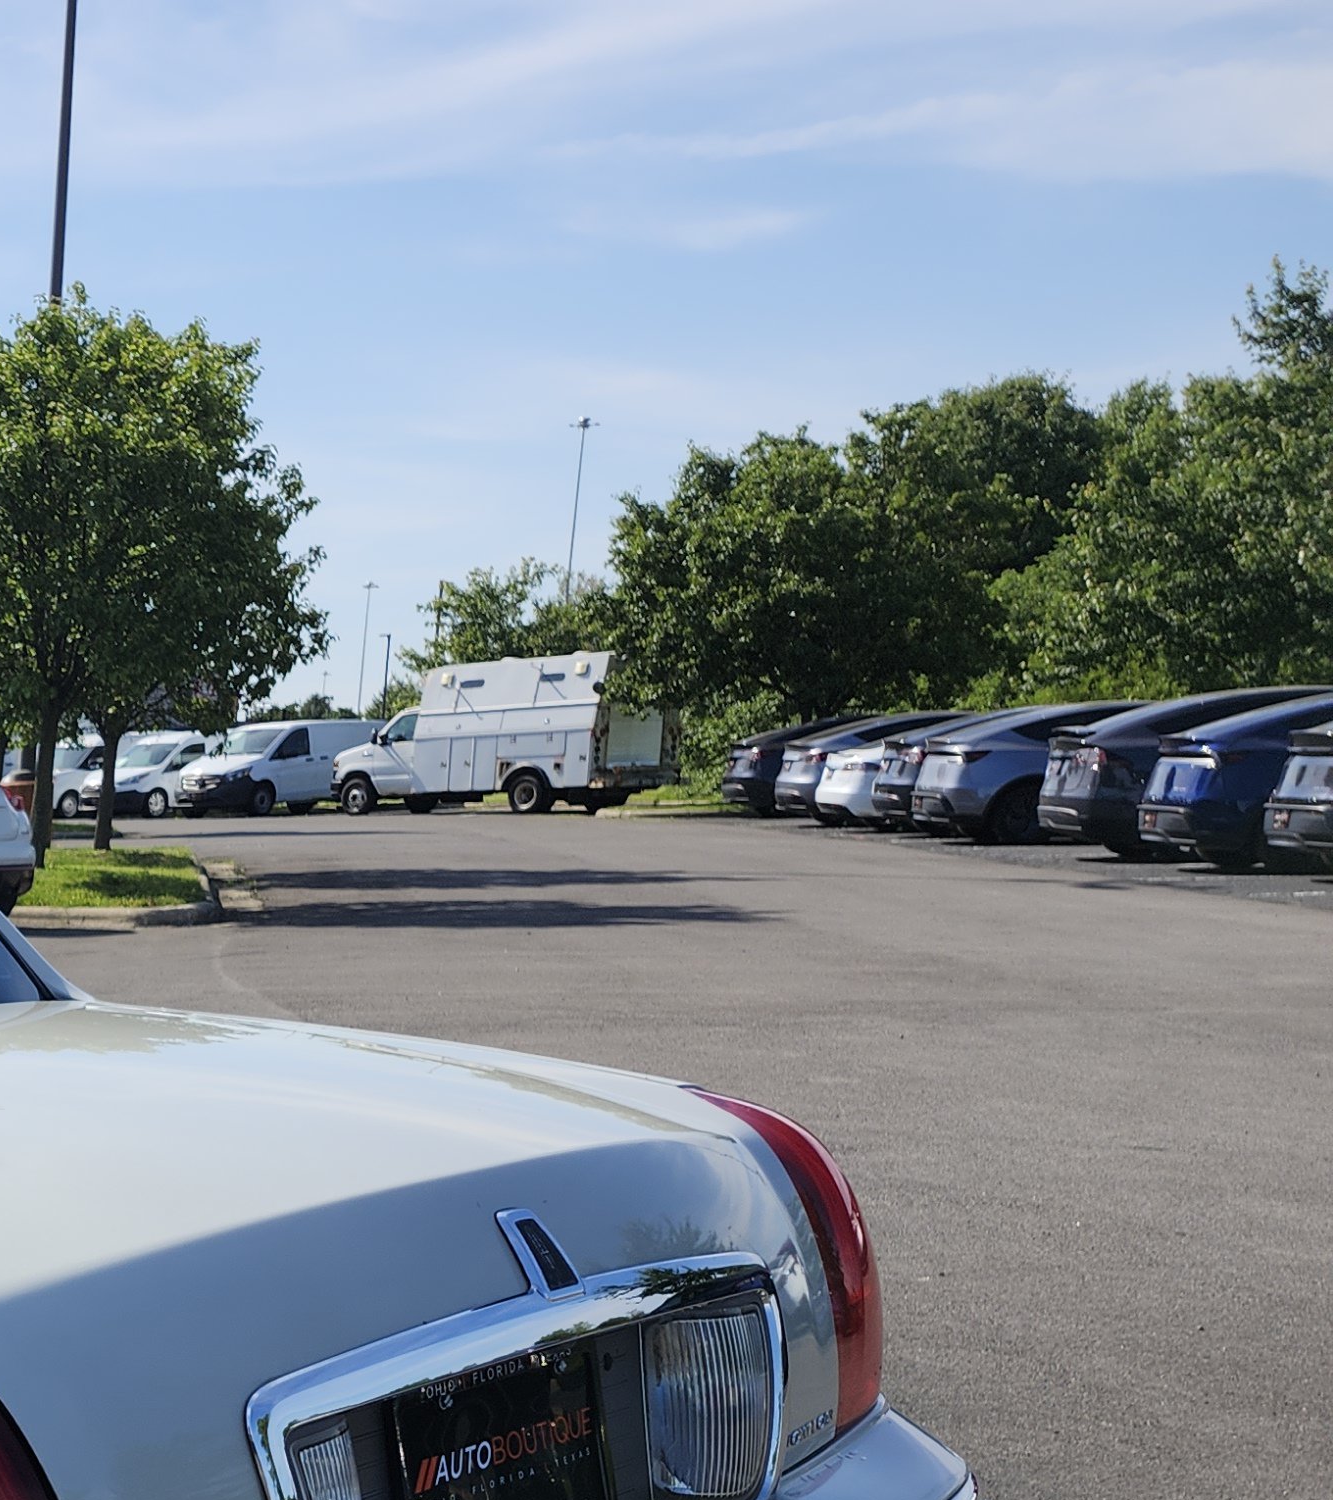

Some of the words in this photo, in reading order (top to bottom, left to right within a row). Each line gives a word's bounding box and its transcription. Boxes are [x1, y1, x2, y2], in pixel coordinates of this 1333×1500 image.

[426, 1379, 456, 1399] OHIO
[472, 1359, 526, 1385] FLORIDA
[471, 1467, 536, 1495] FLORIDA
[554, 1446, 591, 1467] TEXAS
